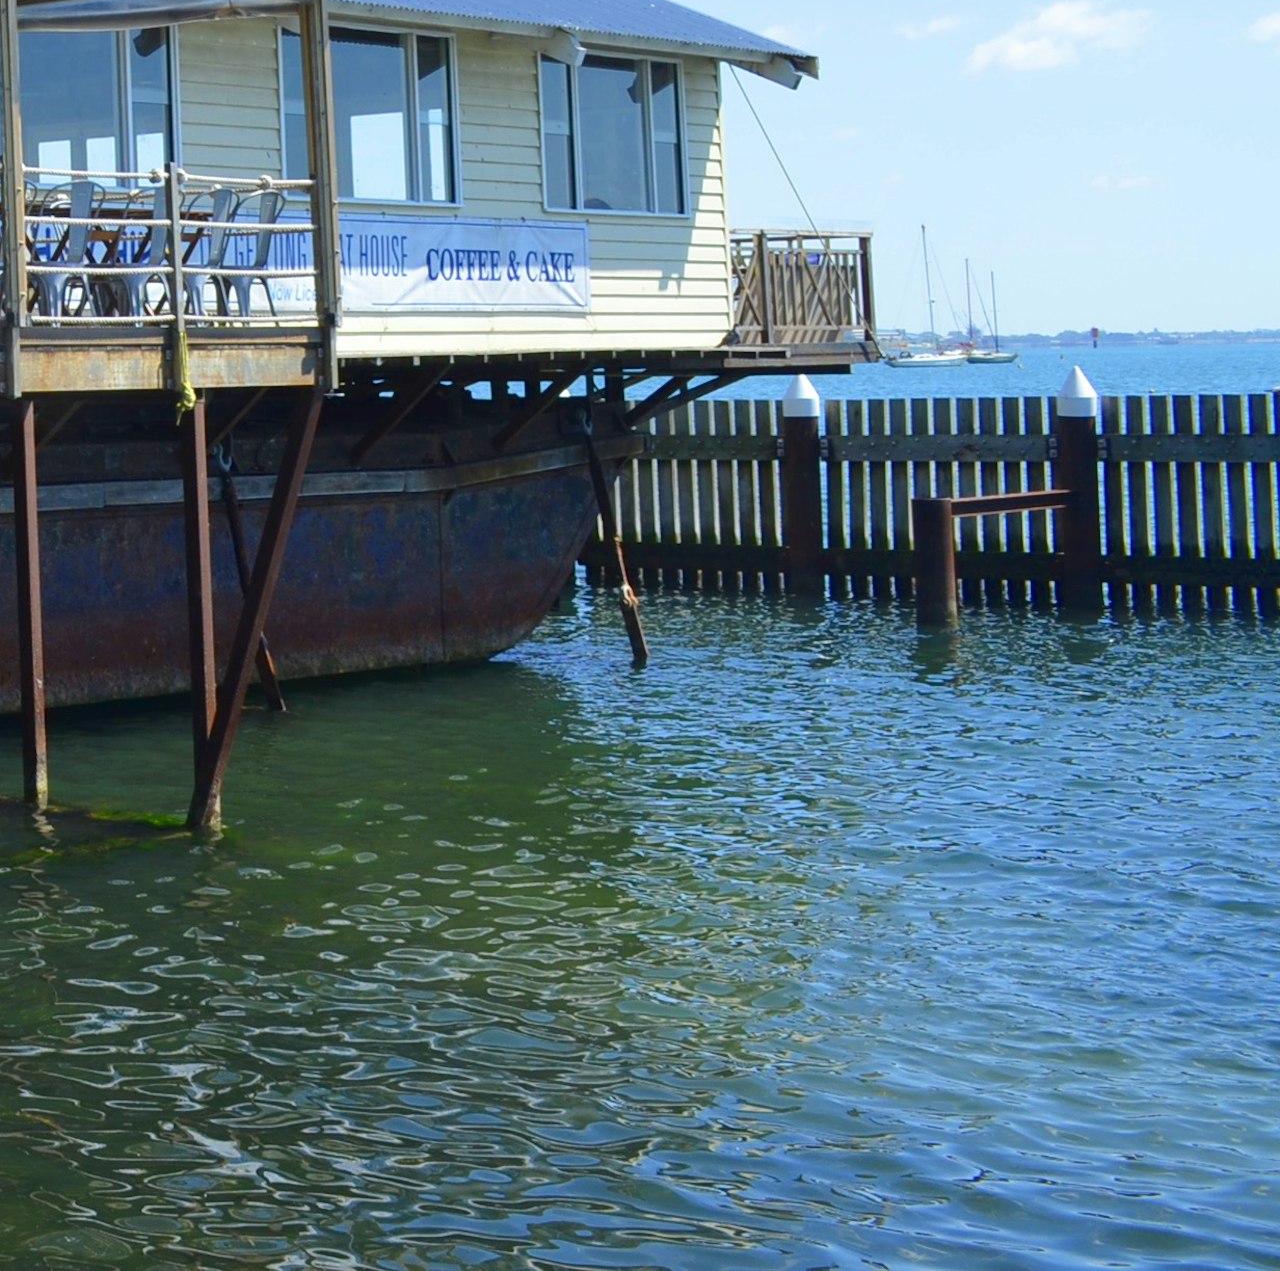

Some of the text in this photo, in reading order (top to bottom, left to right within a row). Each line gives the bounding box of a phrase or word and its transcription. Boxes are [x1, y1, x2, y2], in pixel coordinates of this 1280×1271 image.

[359, 235, 408, 277] HOUSE
[426, 247, 576, 284] COFFEE & CAKE
